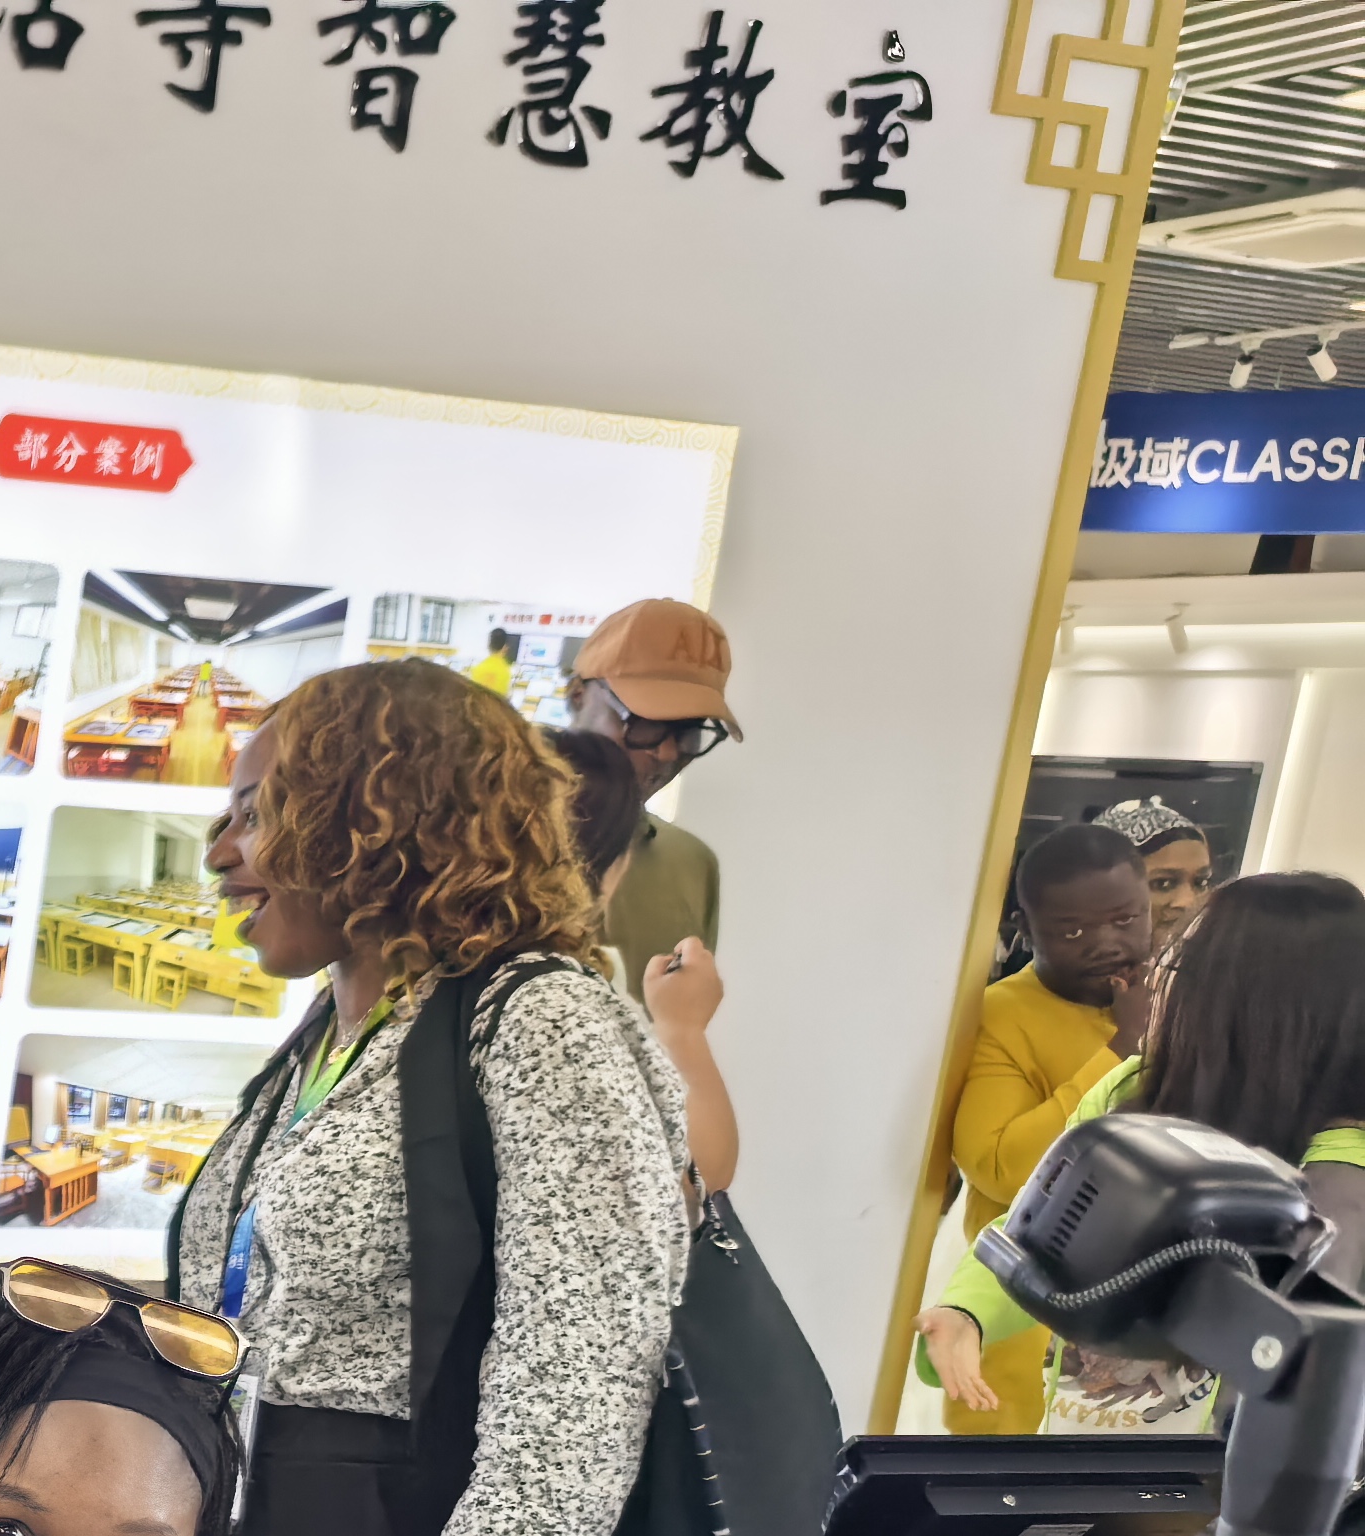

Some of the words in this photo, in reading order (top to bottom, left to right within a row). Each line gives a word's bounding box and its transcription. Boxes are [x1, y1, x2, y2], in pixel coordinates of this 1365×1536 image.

[12, 427, 166, 481] 部分案例
[1090, 419, 1365, 490] 极域CLASS
